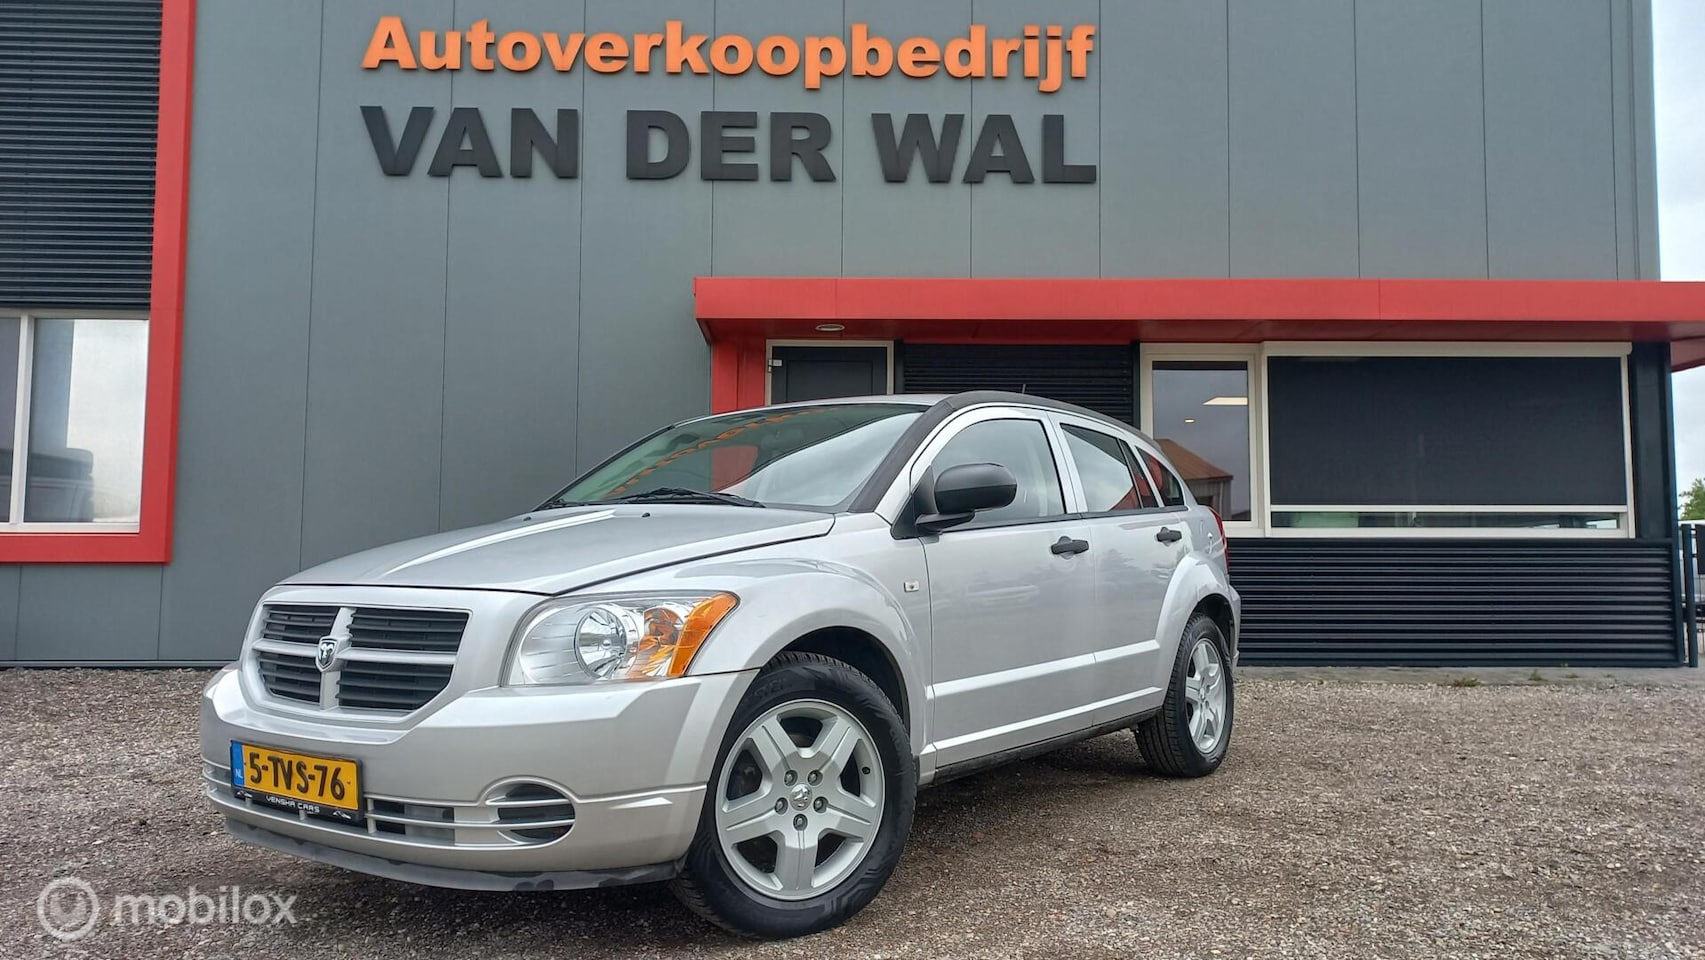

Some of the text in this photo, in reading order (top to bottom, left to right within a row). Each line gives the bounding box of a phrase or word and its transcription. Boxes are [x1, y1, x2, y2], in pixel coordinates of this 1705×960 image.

[361, 16, 1097, 92] Autoverkoopbedrijf
[361, 106, 1098, 184] VAN DER WAL
[235, 768, 243, 778] NL
[249, 752, 345, 800] 5-TVS-76
[297, 802, 320, 813] CARS
